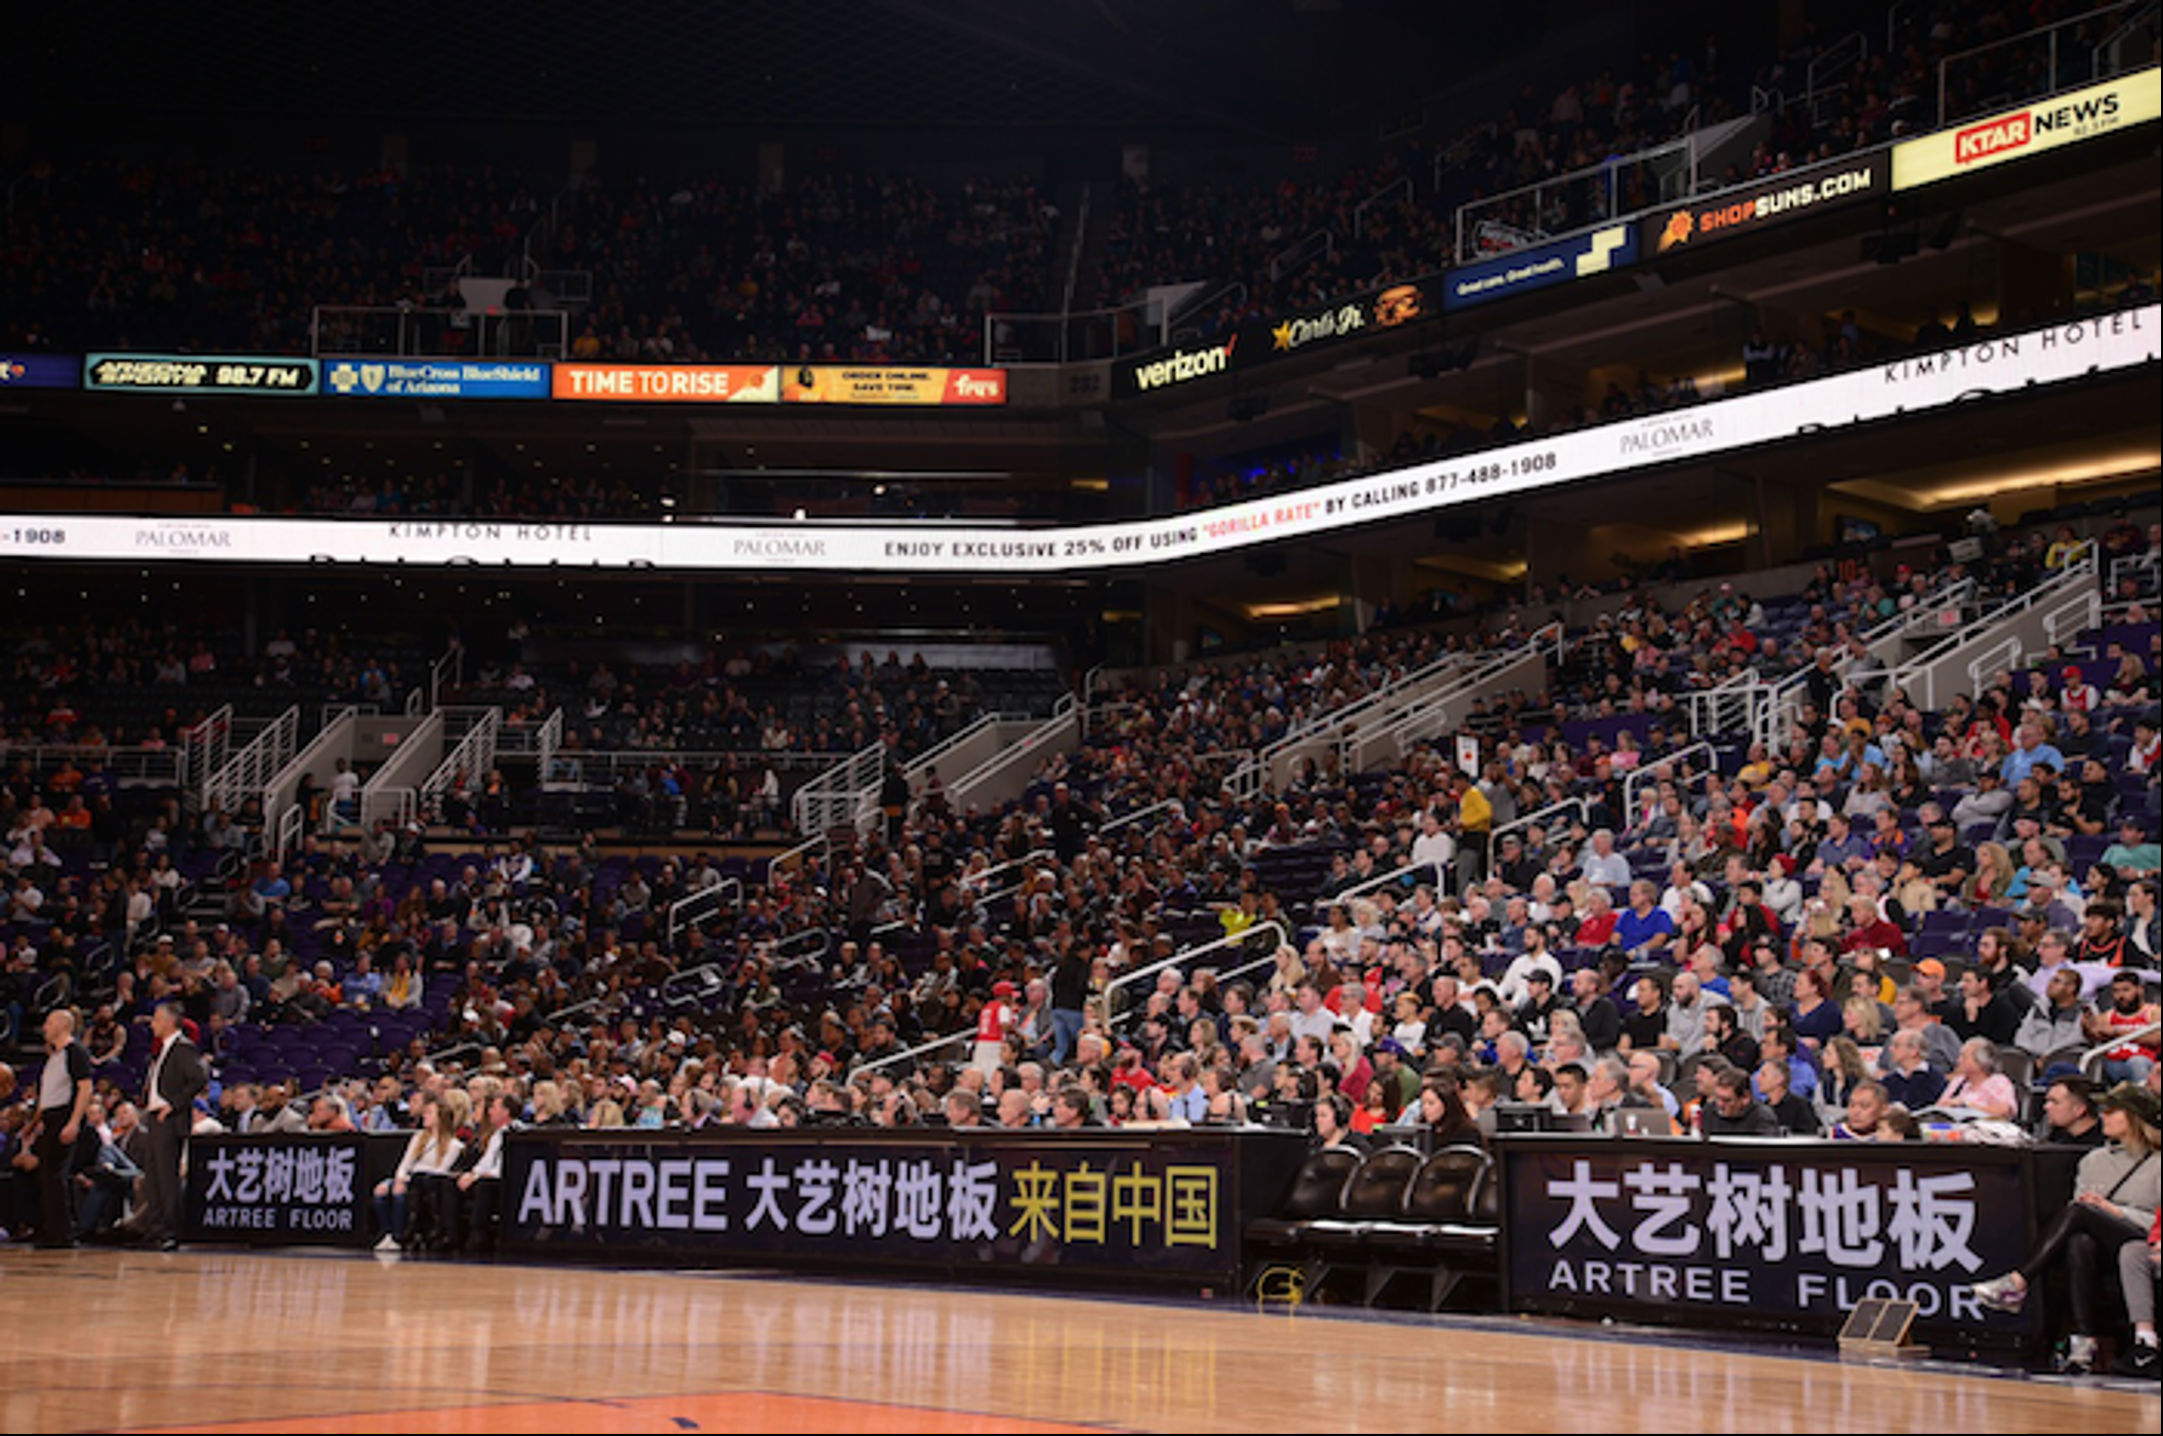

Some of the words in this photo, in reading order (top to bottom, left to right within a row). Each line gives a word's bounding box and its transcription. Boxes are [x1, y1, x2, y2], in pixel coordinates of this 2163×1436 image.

[1959, 120, 2026, 158] KTAR
[2034, 94, 2119, 135] NEWS
[1885, 338, 2019, 383] KIMPTON
[2042, 309, 2143, 349] HOTEL
[215, 366, 265, 384] 98.7
[266, 368, 300, 386] FM
[386, 380, 402, 393] of
[405, 380, 460, 393] Arizona
[569, 370, 633, 393] TIME
[637, 371, 669, 394] TO
[672, 372, 729, 394] RISE
[1135, 345, 1226, 391] verizon
[1620, 420, 1714, 454] PALOMAR
[884, 541, 943, 556] ENJOY
[953, 542, 1055, 557] EXCLUSIVE
[1064, 539, 1105, 556] 25%
[1113, 535, 1143, 552] OFF
[1151, 526, 1197, 548] USING
[1203, 512, 1269, 538] "GORILLA
[1274, 501, 1320, 525] RATE"
[1326, 496, 1345, 515] BY
[1352, 480, 1420, 509] CALLING
[1424, 452, 1557, 494] 877-488-1908
[135, 530, 231, 547] PALOMAR
[388, 523, 500, 539] KIMPTON
[517, 525, 592, 541] HOTEL
[733, 540, 826, 556] PALOMAR
[206, 1147, 355, 1203] 大艺树地板
[203, 1207, 275, 1228] ARTREE
[289, 1208, 352, 1230] FLOOR
[518, 1158, 730, 1231] ARTREE
[745, 1158, 999, 1240] 大艺树地板
[1008, 1160, 1218, 1250] 来自中国
[1547, 1160, 1984, 1274] 大艺树地板
[1548, 1260, 1751, 1303] ARTREE
[1799, 1275, 1985, 1320] FLOOR
